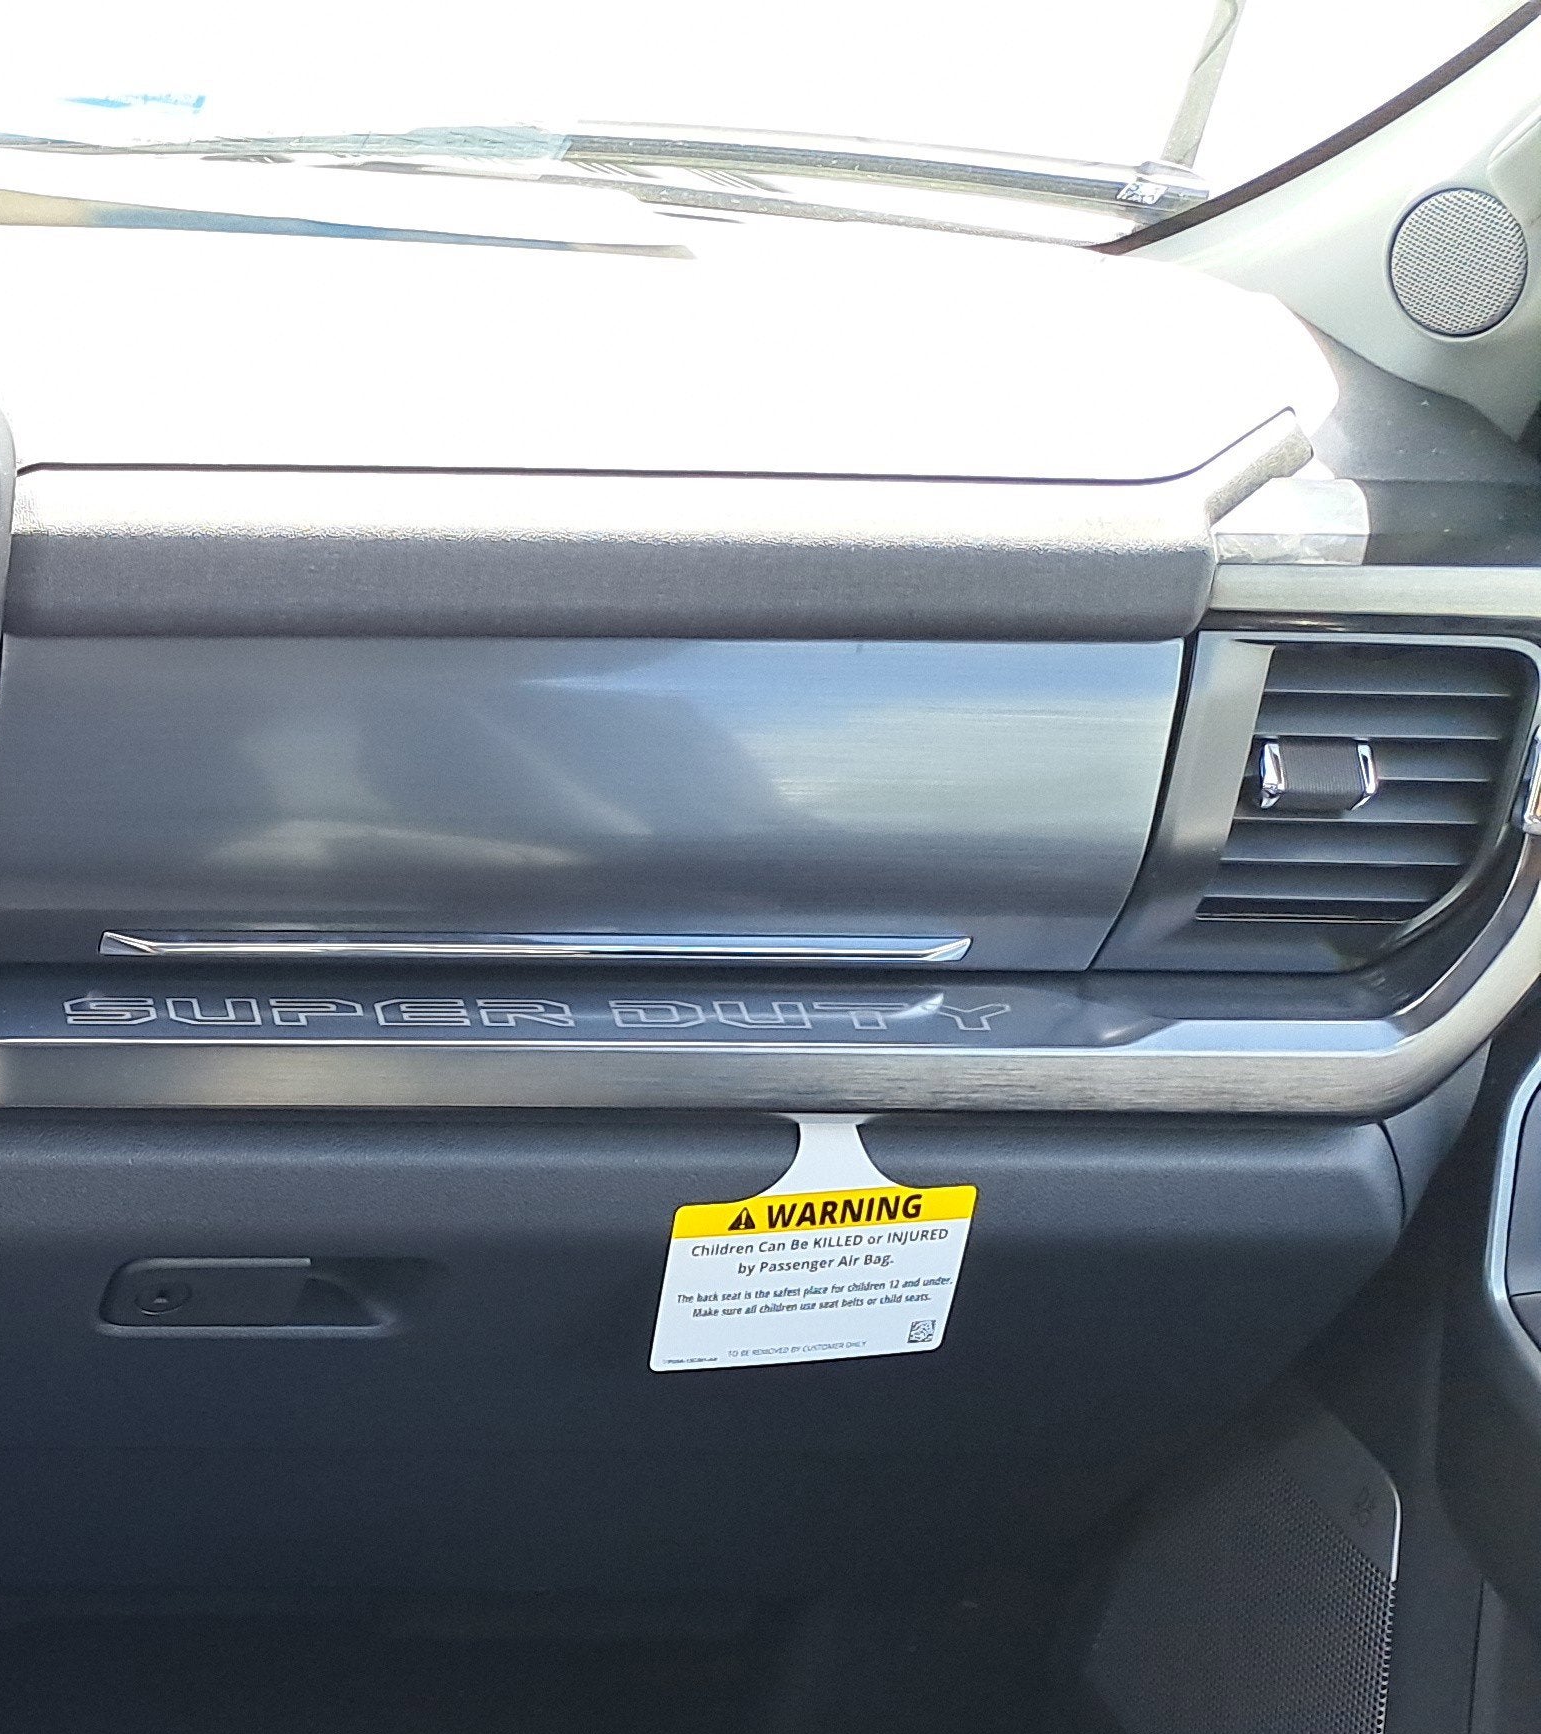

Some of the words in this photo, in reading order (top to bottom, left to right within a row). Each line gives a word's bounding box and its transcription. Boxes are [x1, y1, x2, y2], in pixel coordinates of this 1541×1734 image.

[64, 997, 576, 1027] SUPER
[609, 1000, 1011, 1031] DUTY
[767, 1194, 922, 1230] WARNING
[691, 1243, 754, 1257] Children
[759, 1241, 786, 1253] Can
[791, 1239, 809, 1250] Be
[813, 1235, 863, 1249] KILLED
[867, 1235, 883, 1245] or
[887, 1228, 949, 1246] INJURED
[738, 1262, 755, 1277] by
[760, 1258, 834, 1274] Passenger
[837, 1255, 860, 1268] Air
[864, 1254, 894, 1268] Bag.
[677, 1294, 694, 1304] The
[697, 1291, 718, 1302] back
[721, 1291, 741, 1301] seat
[744, 1290, 751, 1300] is
[755, 1288, 770, 1299] the
[773, 1287, 800, 1298] safest
[803, 1286, 828, 1298] place
[831, 1284, 845, 1294] for
[847, 1281, 885, 1292] children
[889, 1279, 900, 1289] 12
[902, 1277, 920, 1288] and
[693, 1307, 719, 1318] Make
[722, 1307, 742, 1316] sure
[744, 1304, 757, 1315] all
[759, 1303, 797, 1314] children
[800, 1303, 816, 1311] use
[819, 1300, 838, 1310] seat
[841, 1297, 864, 1308] belts
[867, 1298, 877, 1306] or
[880, 1294, 902, 1304] child
